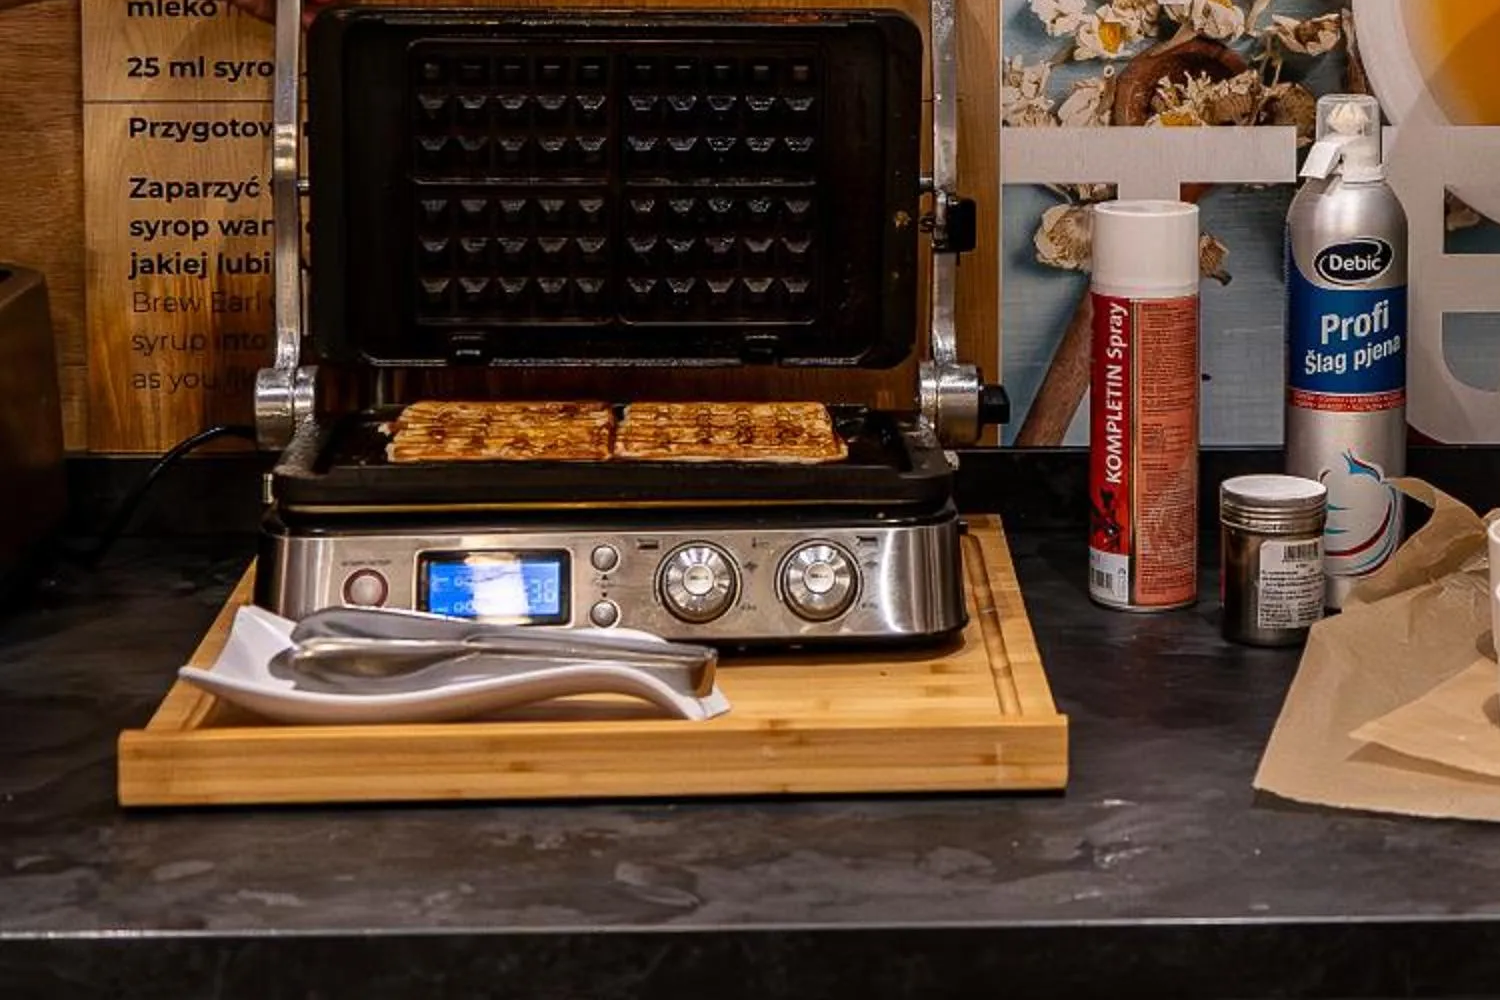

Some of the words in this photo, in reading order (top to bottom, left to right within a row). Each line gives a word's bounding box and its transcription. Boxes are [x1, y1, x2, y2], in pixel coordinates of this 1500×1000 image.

[127, 57, 160, 78] 25
[170, 55, 205, 78] ml
[213, 61, 275, 83] syro
[129, 176, 260, 203] Zaparzyć
[130, 218, 209, 241] syrop
[128, 252, 208, 280] jakiej
[1329, 253, 1382, 271] Debic
[133, 291, 201, 313] Brew
[1106, 302, 1129, 359] Spray
[1321, 299, 1389, 344] Profi
[132, 333, 207, 356] syrup
[1305, 350, 1347, 375] Šlag
[133, 373, 161, 389] as
[1106, 365, 1123, 484] KOMPLETIN
